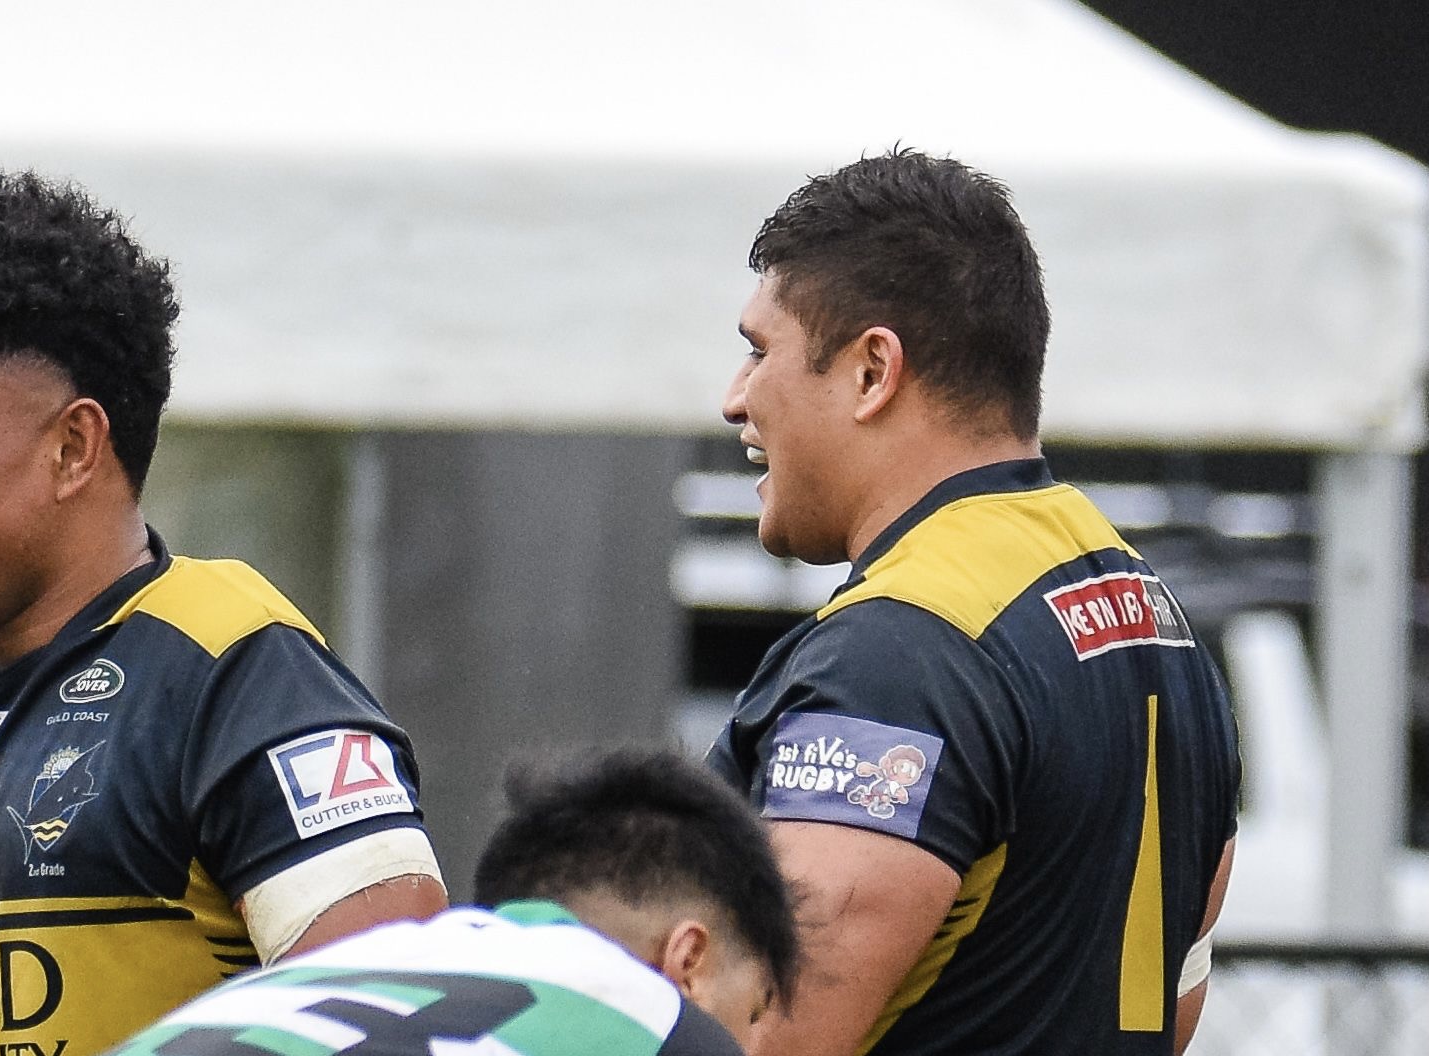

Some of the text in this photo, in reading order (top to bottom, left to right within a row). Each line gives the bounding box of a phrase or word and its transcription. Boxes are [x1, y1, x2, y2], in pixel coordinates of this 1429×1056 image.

[73, 712, 110, 722] COAST
[772, 763, 855, 793] RUGBY
[301, 793, 408, 829] CUTTER & BUCK
[1120, 695, 1164, 1031] 1
